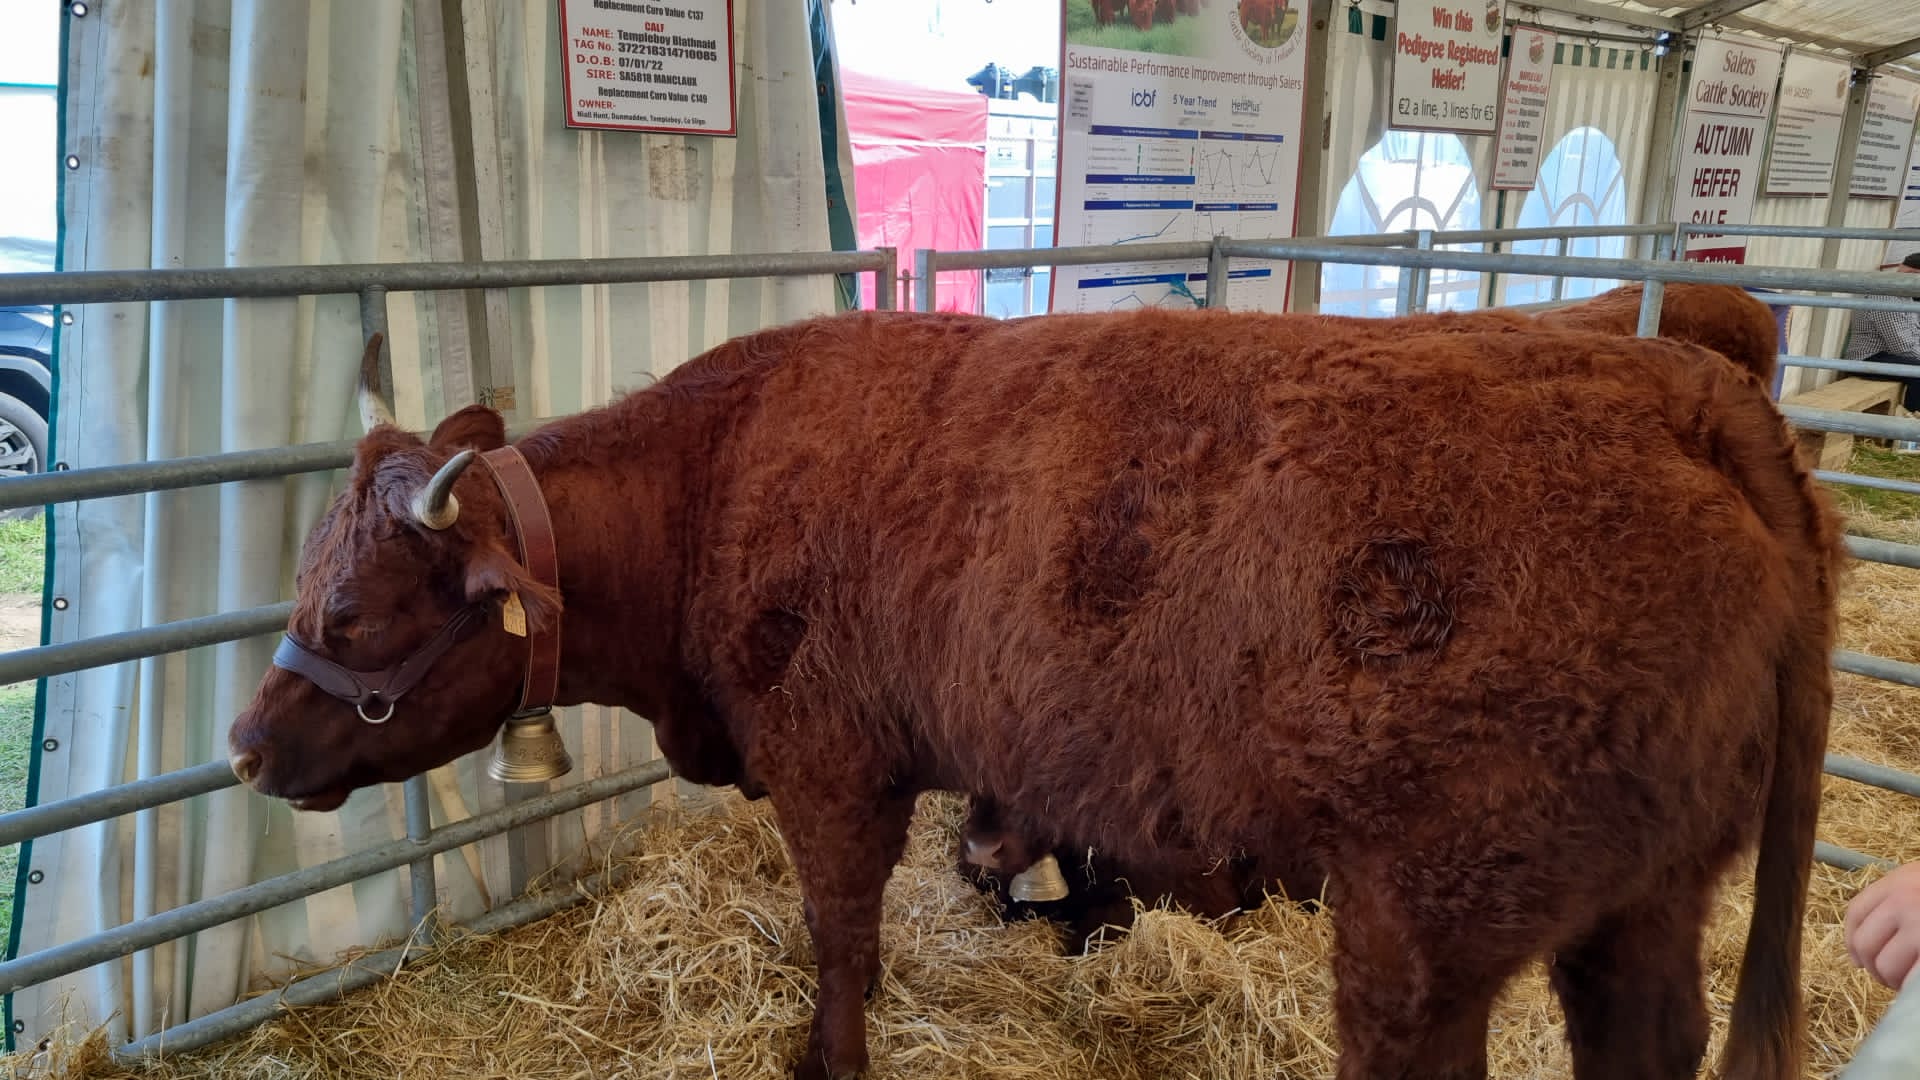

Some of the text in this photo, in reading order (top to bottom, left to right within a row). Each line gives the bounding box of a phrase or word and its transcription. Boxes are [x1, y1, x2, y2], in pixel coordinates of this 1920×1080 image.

[593, 0, 645, 13] Replacement
[664, 7, 685, 18] Value
[1432, 6, 1473, 32] Win this
[582, 27, 614, 38] NAME:
[617, 29, 671, 46] Templeboy
[644, 21, 664, 33] CALF
[573, 38, 595, 50] TAG
[597, 41, 615, 52] No.
[1398, 32, 1499, 67] Pedigree Registered
[576, 54, 615, 66] D.O.B:
[1068, 52, 1302, 90] Sustainable Performance Improvement through Salers
[1722, 49, 1756, 76] Salers
[586, 68, 615, 80] SIRE:
[1432, 68, 1466, 91] Heifer!
[598, 86, 649, 99] Replacement
[668, 92, 689, 102] Value
[1173, 94, 1217, 108] 5 Year Trend
[1696, 79, 1769, 113] Cattle Society
[1399, 97, 1410, 115] €2
[1413, 102, 1419, 115] a
[1421, 99, 1439, 119] line,
[1442, 101, 1448, 118] 3
[1451, 102, 1469, 119] lines
[1471, 104, 1482, 120] for
[1484, 105, 1494, 121] €5
[1694, 123, 1754, 156] AUTUMN
[1691, 167, 1742, 198] HEIFER
